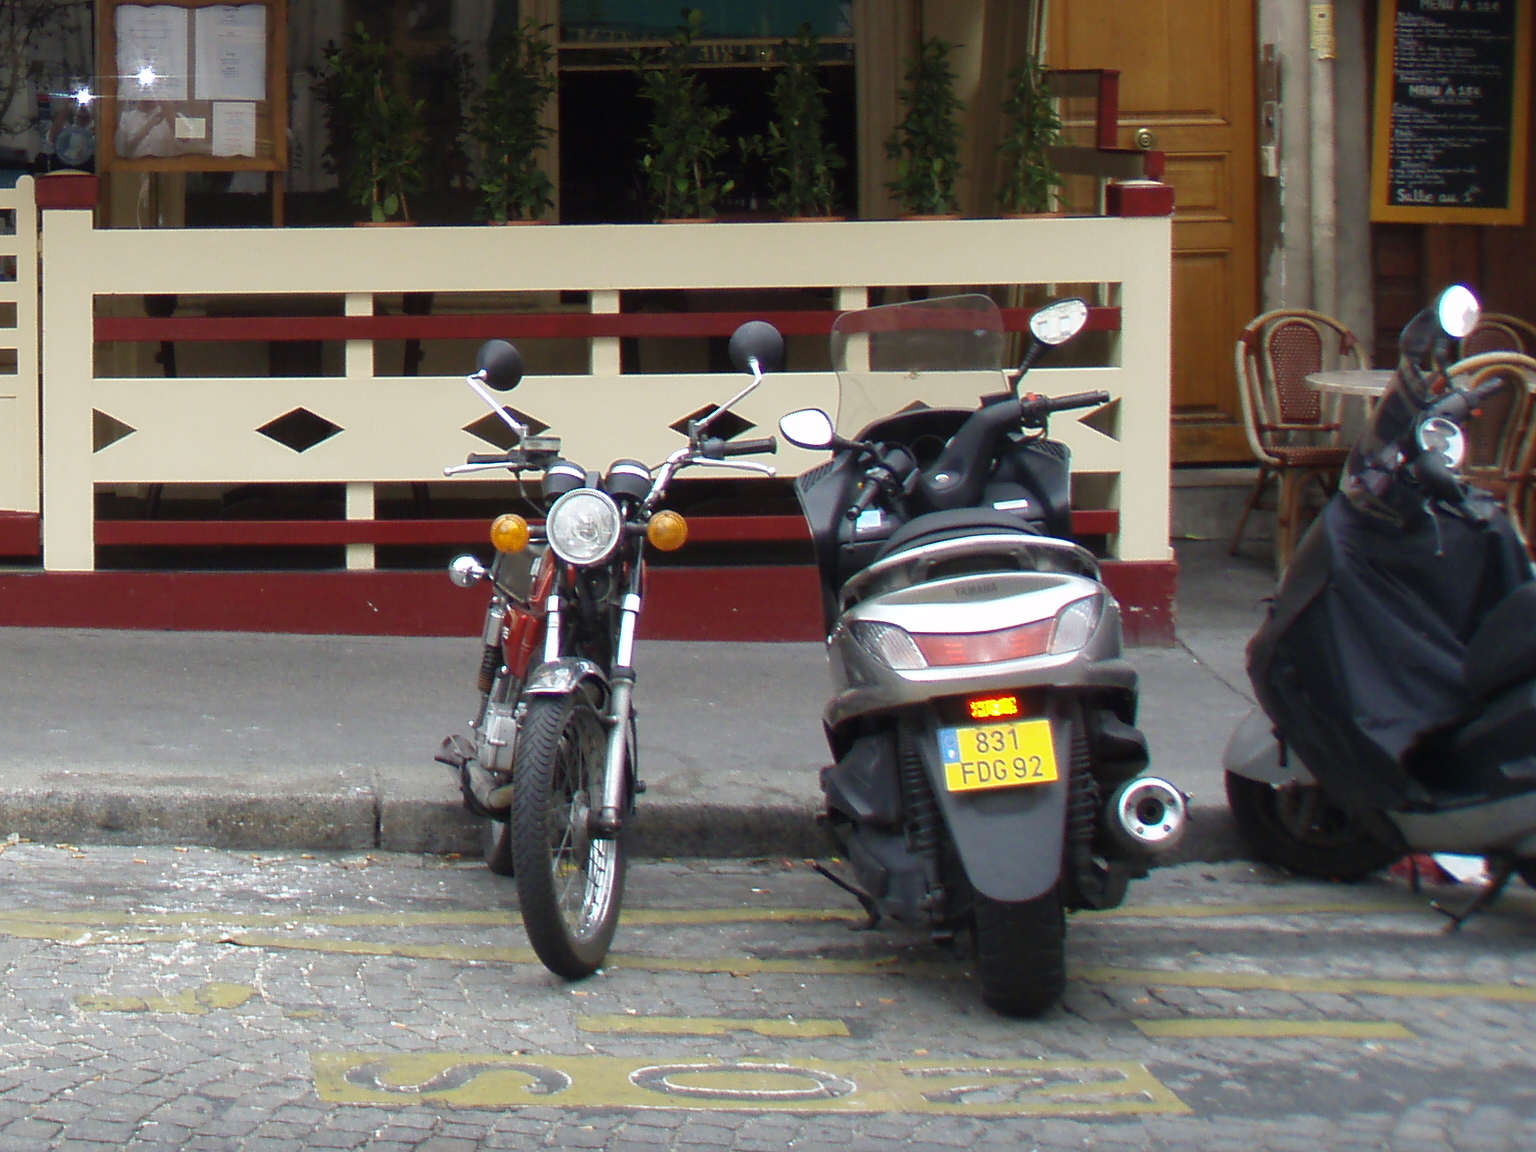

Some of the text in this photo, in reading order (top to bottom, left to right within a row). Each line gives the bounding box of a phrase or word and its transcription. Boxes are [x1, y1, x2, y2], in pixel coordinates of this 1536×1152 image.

[975, 729, 1019, 754] 831
[961, 755, 1044, 785] FDG 92
